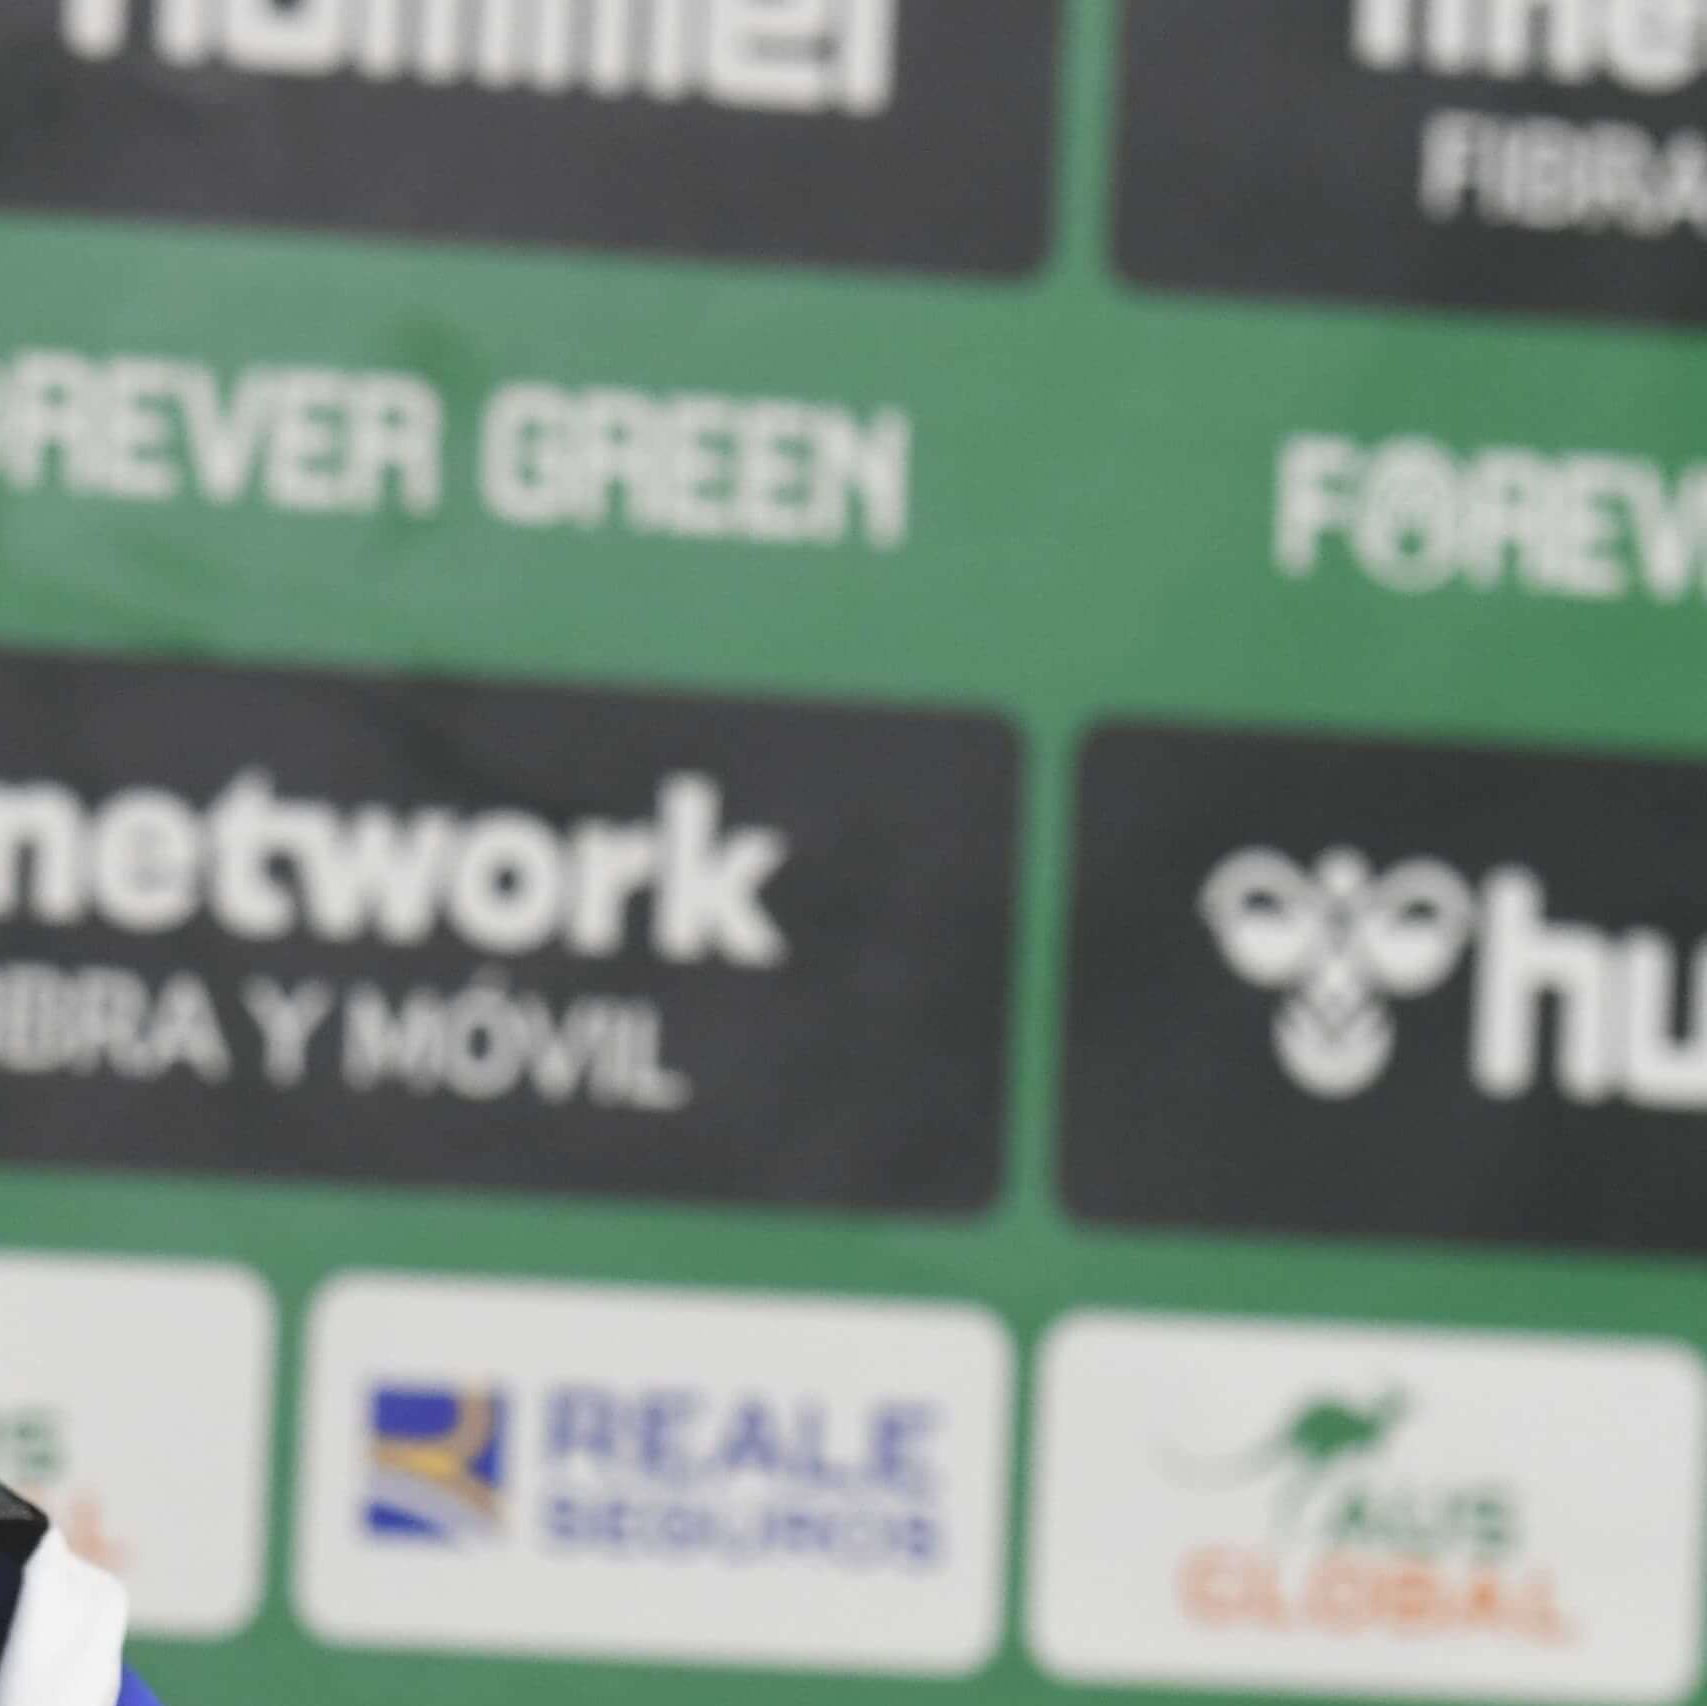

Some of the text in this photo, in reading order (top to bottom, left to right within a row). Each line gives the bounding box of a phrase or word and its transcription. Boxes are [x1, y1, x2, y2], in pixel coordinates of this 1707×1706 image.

[60, 0, 899, 118] mmel
[480, 380, 912, 548] GREEN
[242, 985, 334, 1090] Y
[344, 968, 692, 1112] MÓVIL
[545, 1380, 945, 1498] REALE
